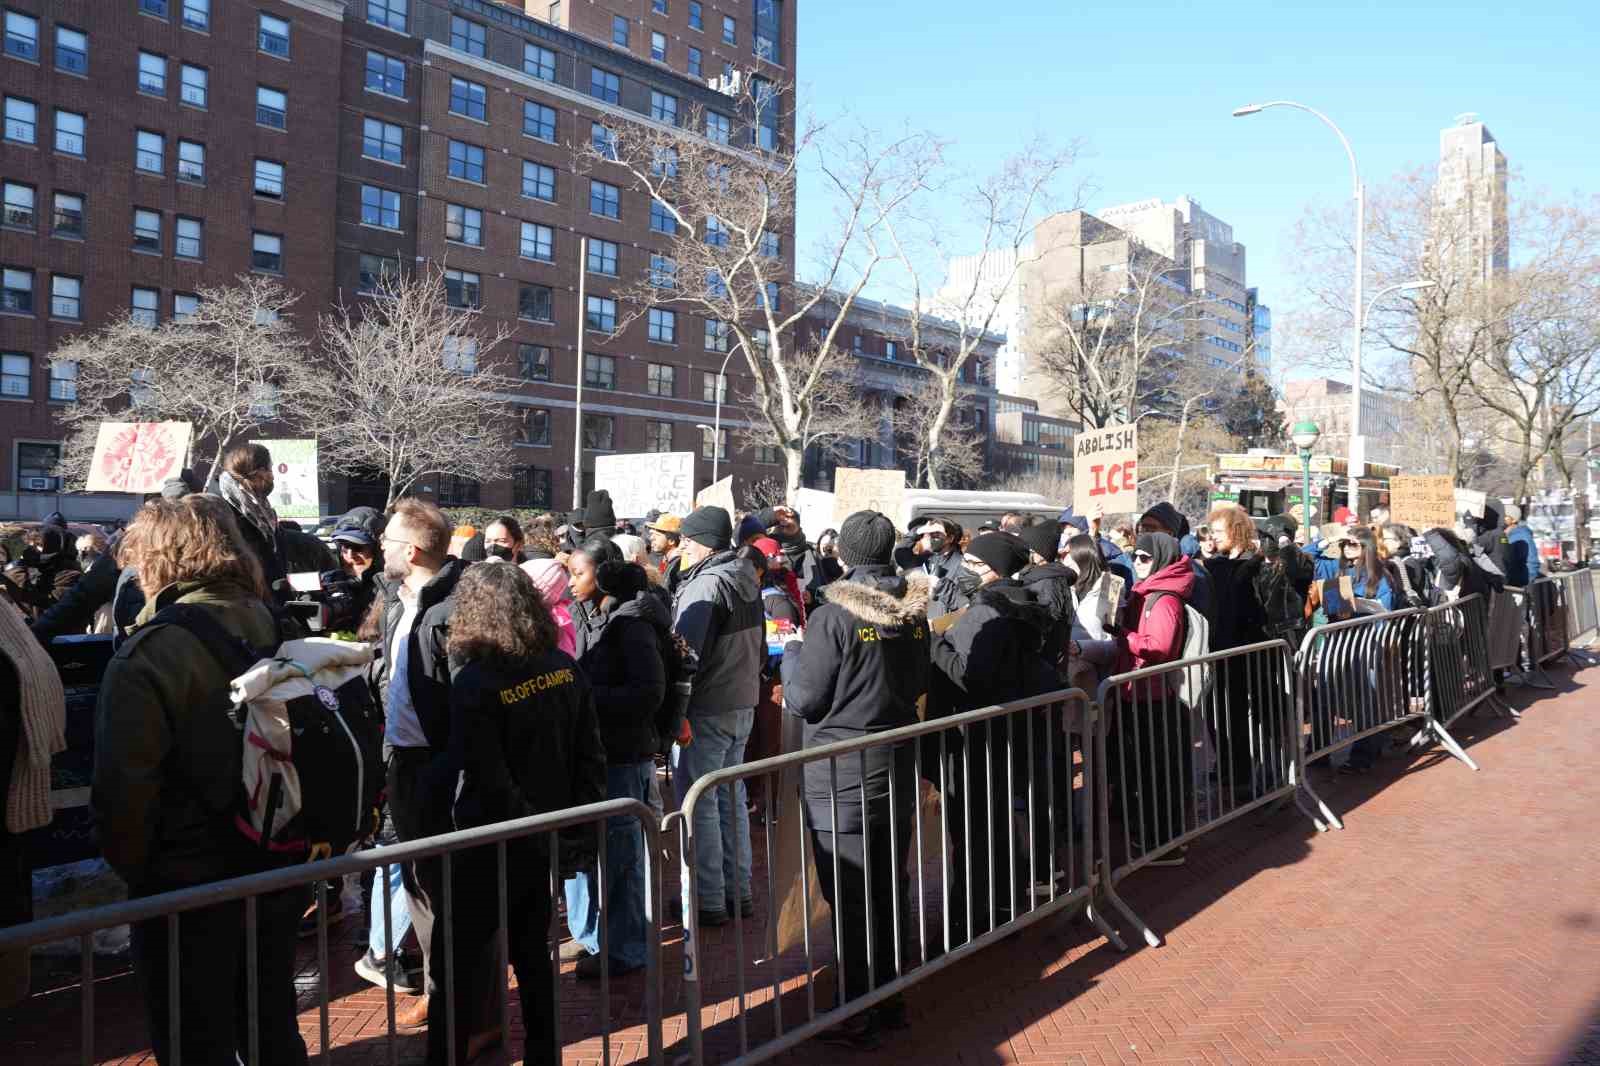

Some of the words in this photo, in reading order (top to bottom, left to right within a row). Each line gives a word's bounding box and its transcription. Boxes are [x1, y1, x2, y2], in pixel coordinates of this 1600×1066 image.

[1077, 429, 1133, 457] ABOLISH
[1089, 460, 1136, 496] ICE
[858, 627, 875, 641] ICE
[515, 679, 537, 699] OFF
[536, 668, 574, 690] CAMPUS
